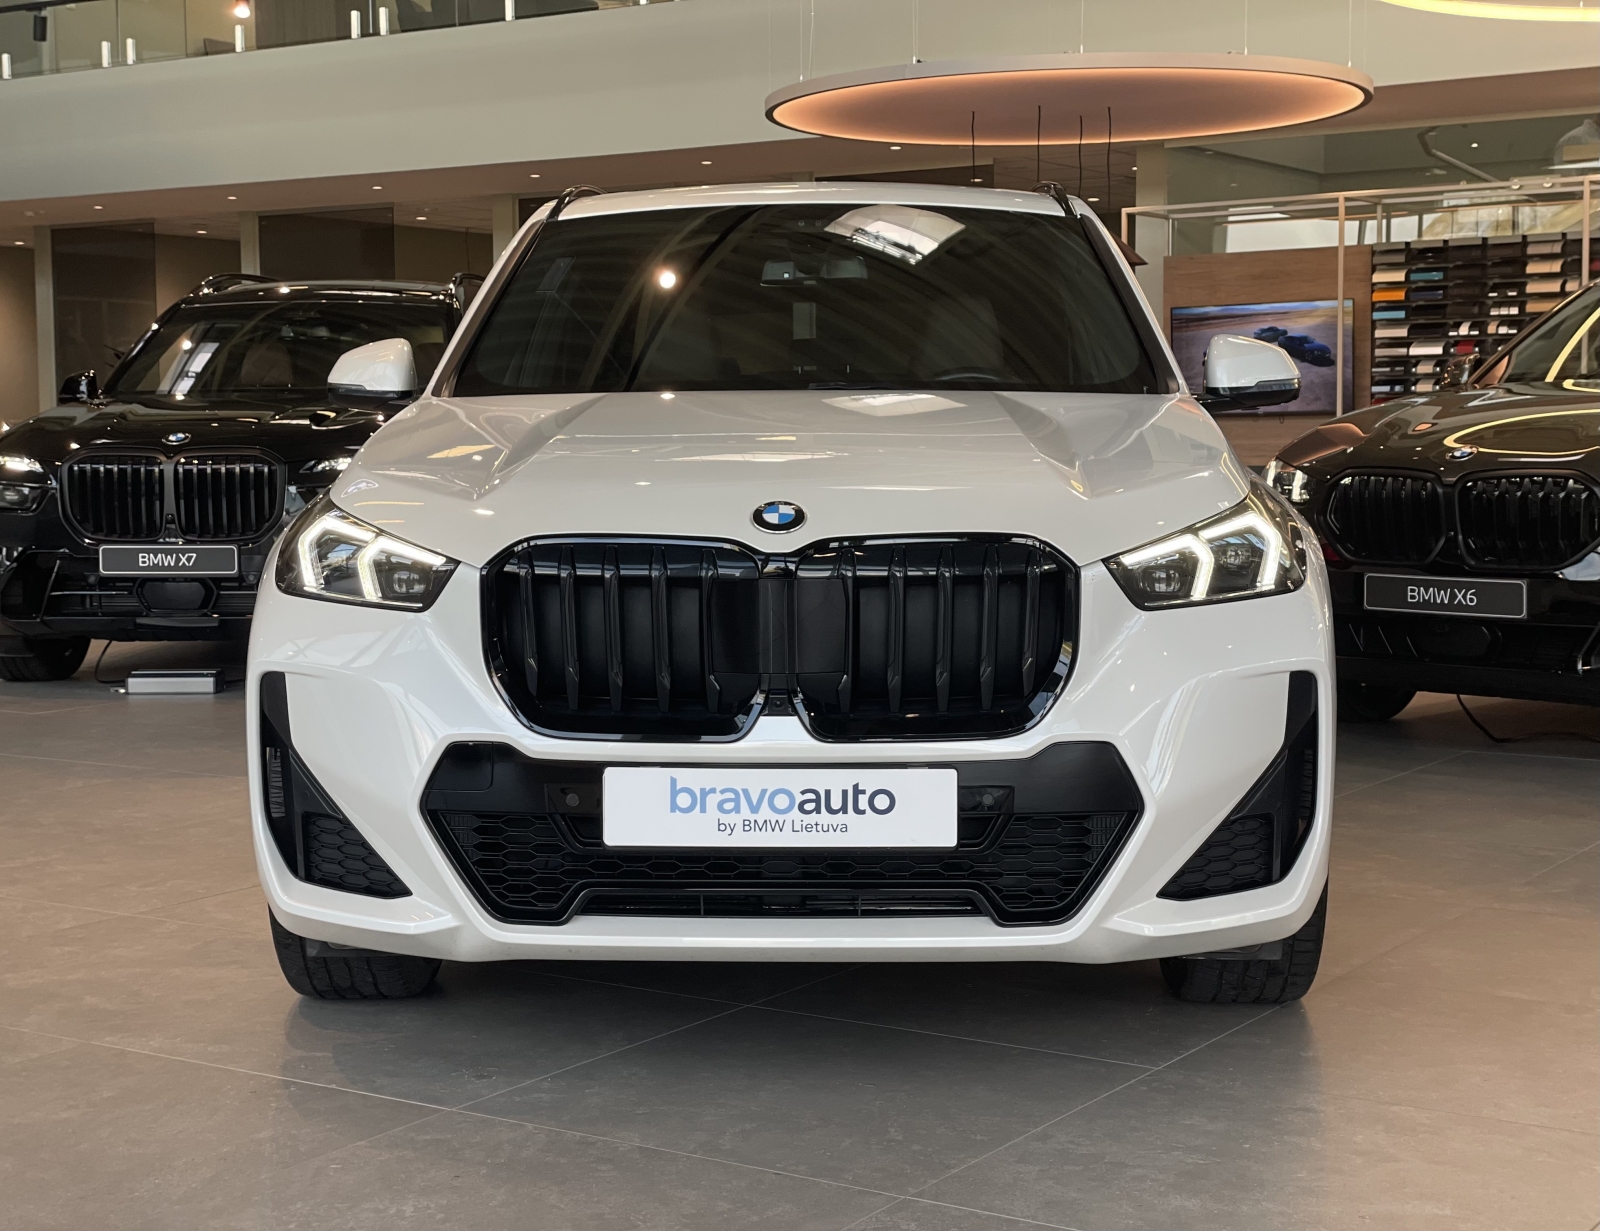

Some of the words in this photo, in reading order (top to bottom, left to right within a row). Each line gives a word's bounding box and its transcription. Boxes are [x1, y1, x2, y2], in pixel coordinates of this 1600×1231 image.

[138, 553, 176, 566] BMW
[178, 553, 197, 566] X7
[1407, 586, 1451, 604] BMW
[1453, 588, 1477, 606] X6
[669, 775, 896, 816] bravoauto
[717, 818, 736, 836] by
[742, 819, 786, 833] BMW
[791, 819, 848, 833] Lietuva
